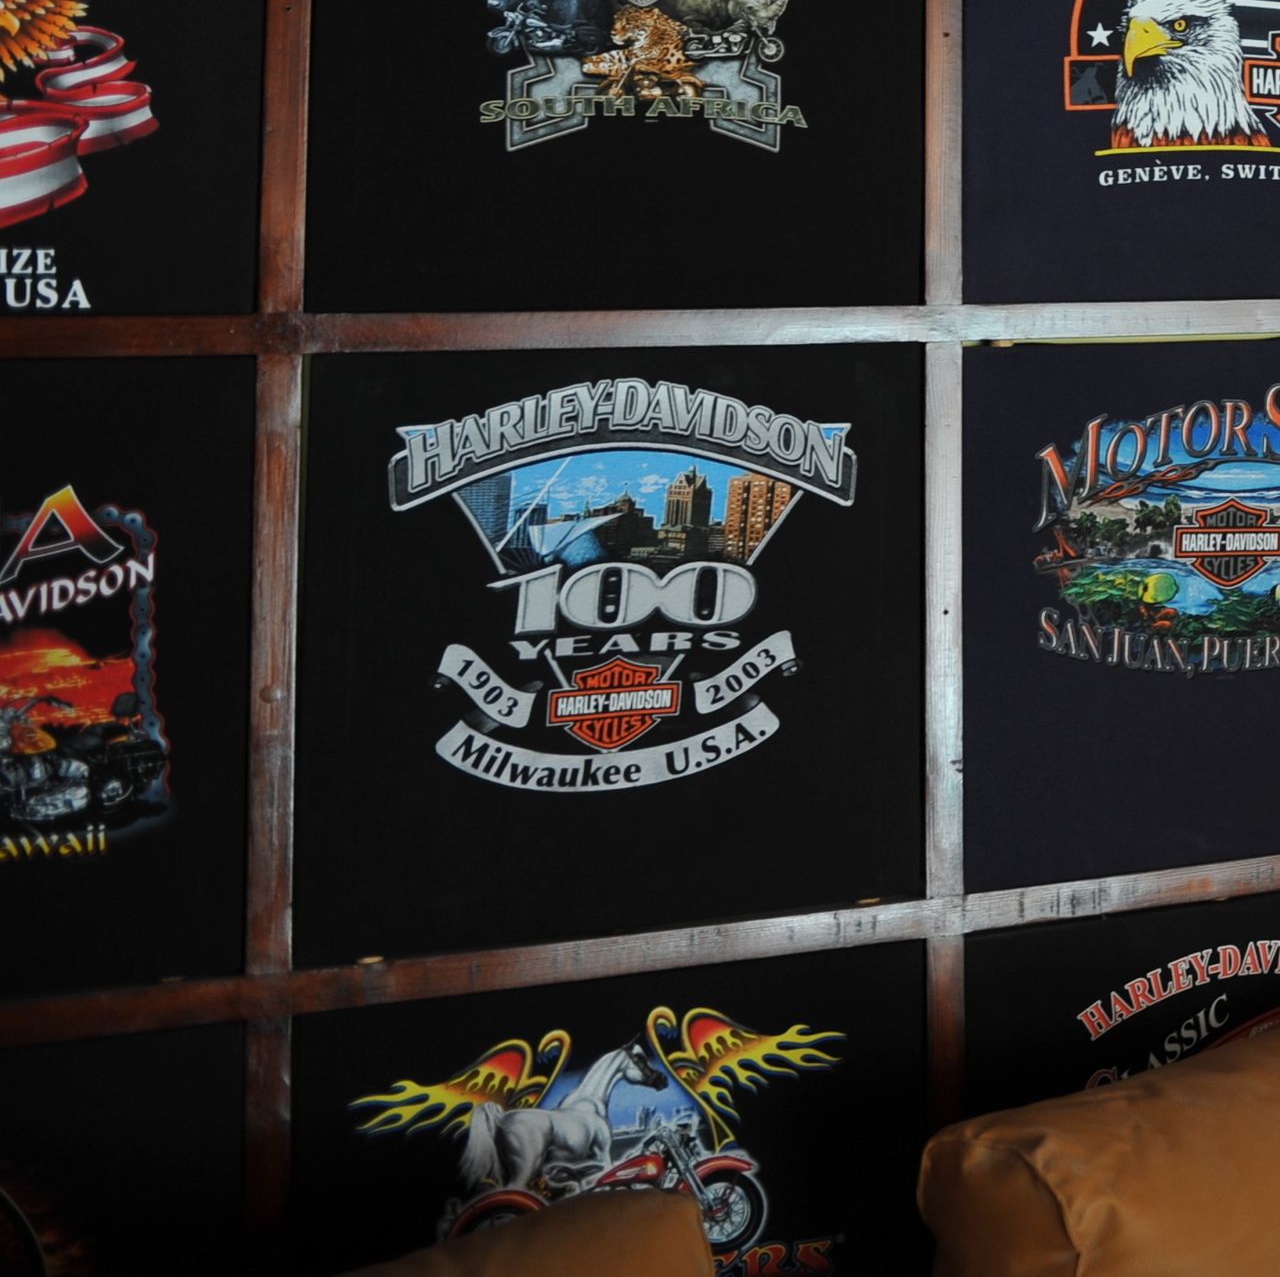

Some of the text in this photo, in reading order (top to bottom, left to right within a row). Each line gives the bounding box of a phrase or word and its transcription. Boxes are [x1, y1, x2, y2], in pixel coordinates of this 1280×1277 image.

[480, 96, 808, 128] SOUTH AFRICA
[1098, 159, 1210, 187] GENÈVE,
[5, 279, 92, 309] USA
[403, 377, 847, 491] HARLEY-DAVIDSON
[1205, 510, 1258, 527] MOTOR
[1181, 531, 1279, 551] HARLEY-DAVIDSON
[1203, 557, 1258, 580] CYCLES
[486, 562, 758, 636] 100
[508, 630, 742, 661] YEARS
[1039, 606, 1103, 663] SAN
[1107, 625, 1196, 678] JUAN,
[455, 657, 521, 719] 1903
[586, 671, 648, 688] MOTOR
[706, 645, 780, 705] 2003
[557, 688, 672, 717] HARLEY-DAVIDSON
[580, 715, 645, 741] CYCLES
[449, 720, 768, 790] Milwaukee U.S.A.
[1085, 993, 1231, 1090] CASSIC
